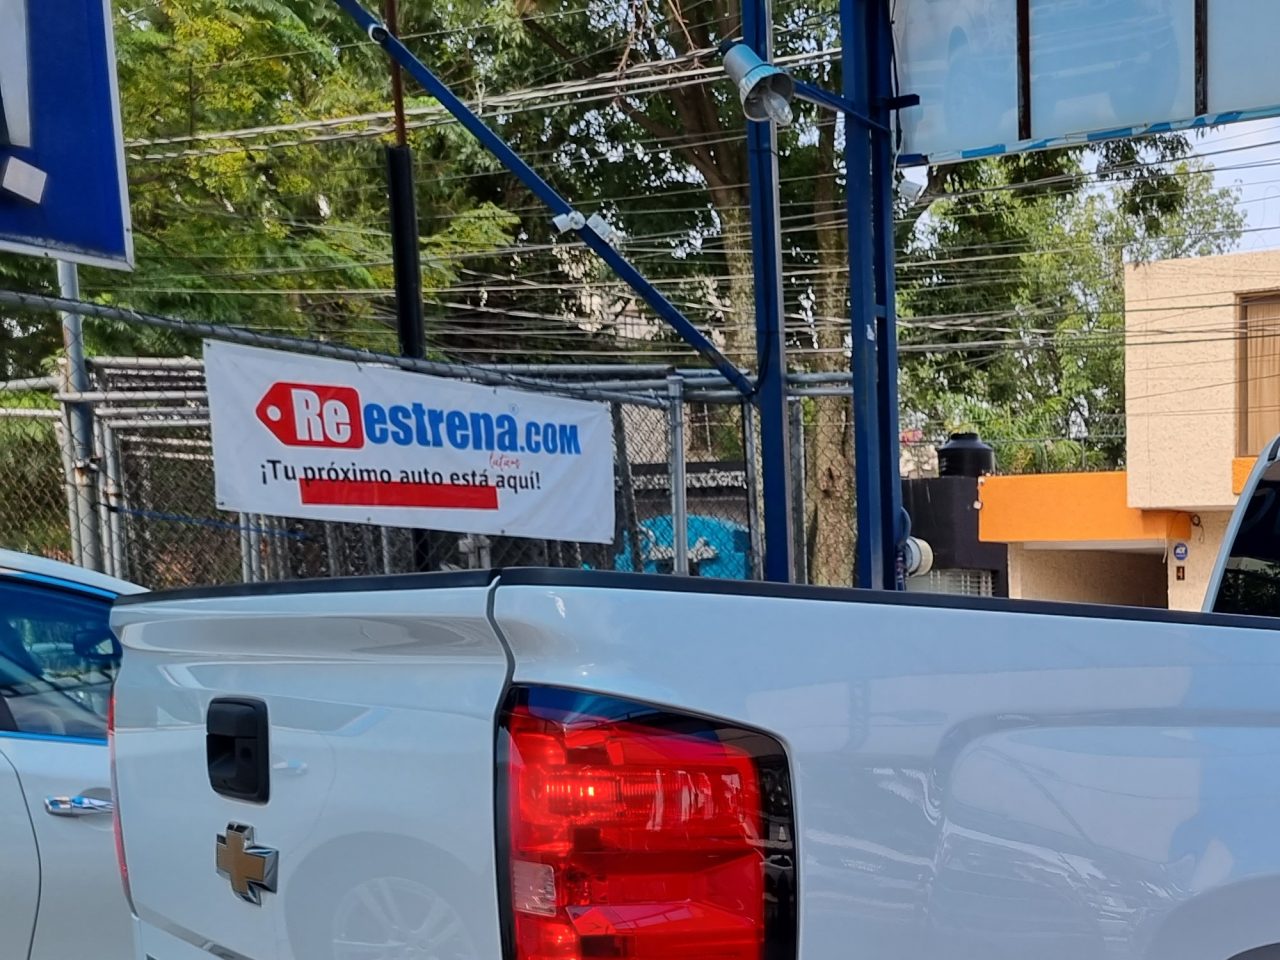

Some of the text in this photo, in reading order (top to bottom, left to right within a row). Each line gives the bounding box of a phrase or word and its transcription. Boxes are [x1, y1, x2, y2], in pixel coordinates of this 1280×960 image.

[260, 459, 541, 494] ¡Tu próximo auto está aquí!
